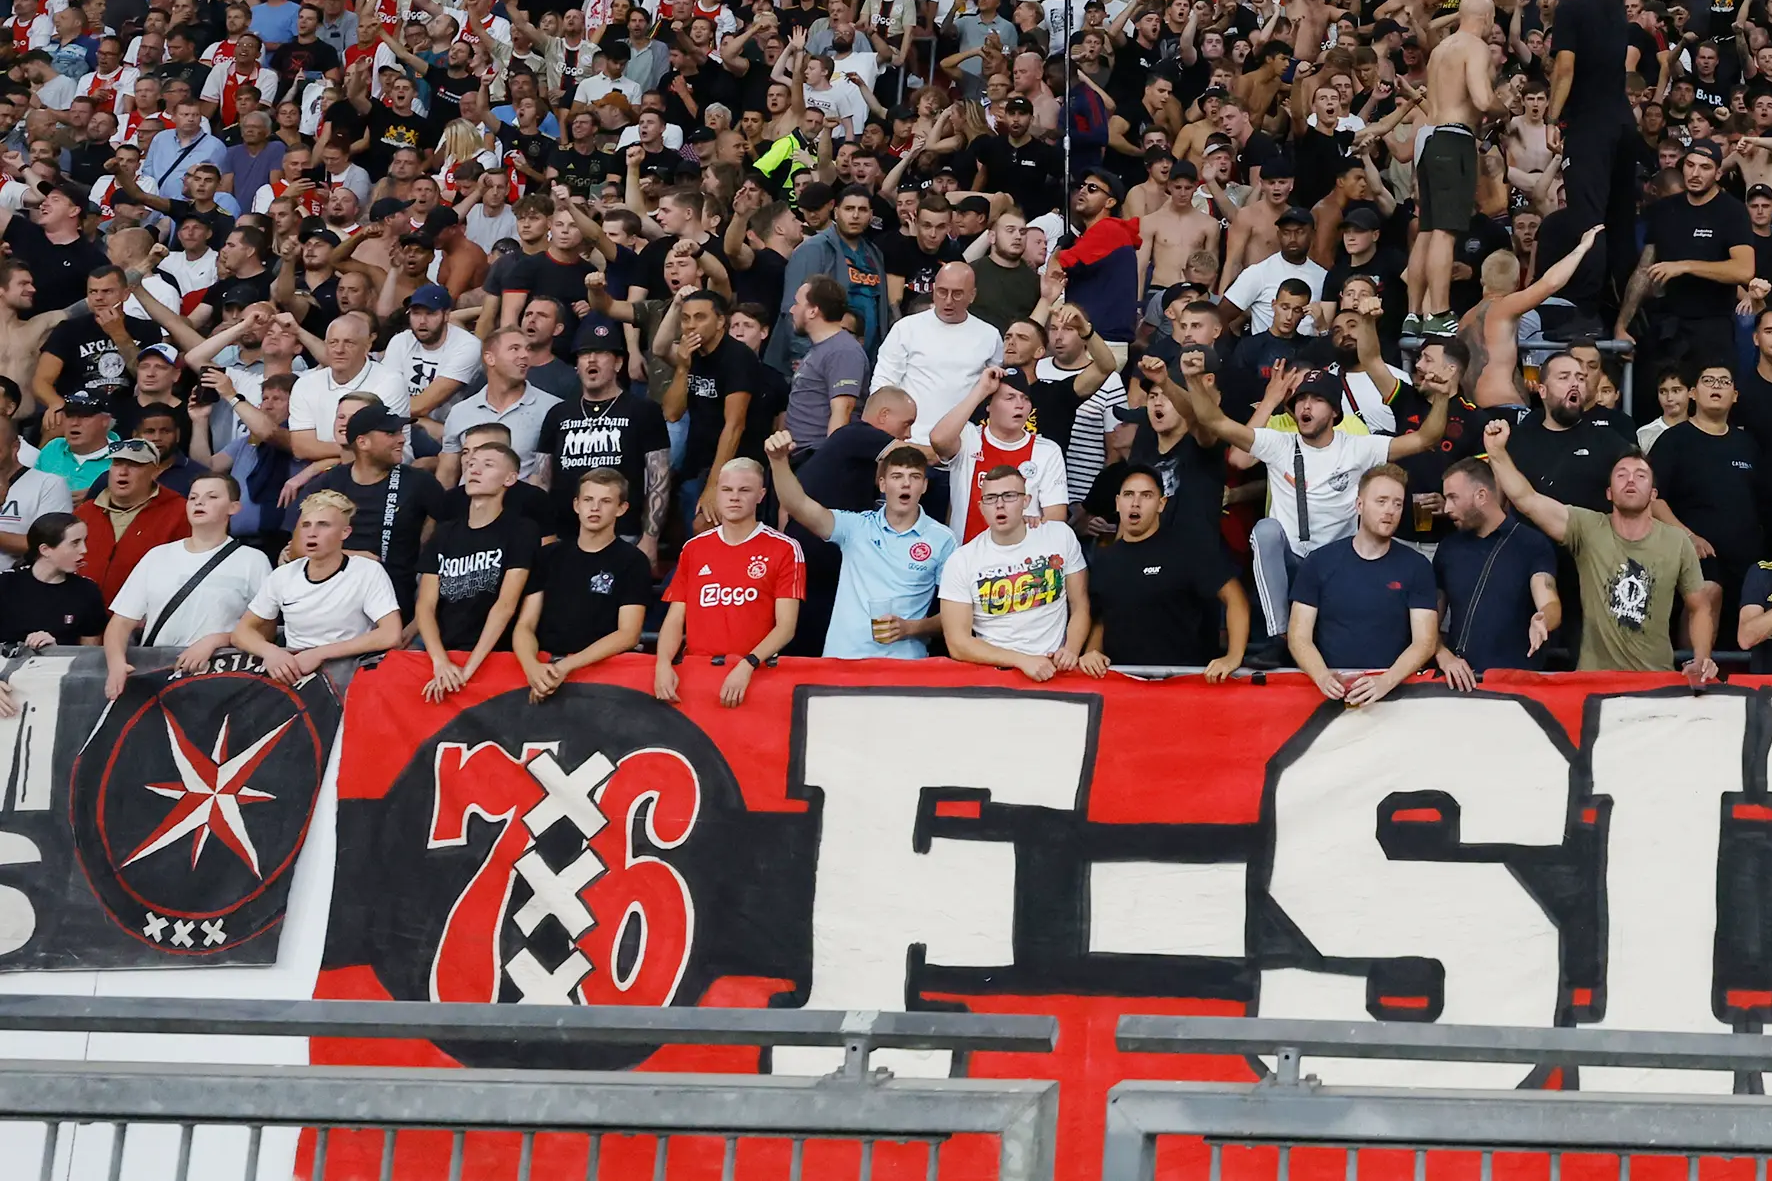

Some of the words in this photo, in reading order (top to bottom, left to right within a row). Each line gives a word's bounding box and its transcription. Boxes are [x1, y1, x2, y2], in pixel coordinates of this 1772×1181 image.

[556, 62, 584, 75] Ziggo
[560, 416, 629, 432] Amsterdam
[560, 453, 622, 470] Hooligans
[383, 492, 398, 527] SEASIDE
[700, 583, 759, 607] Ziggo
[977, 568, 1058, 616] 1964
